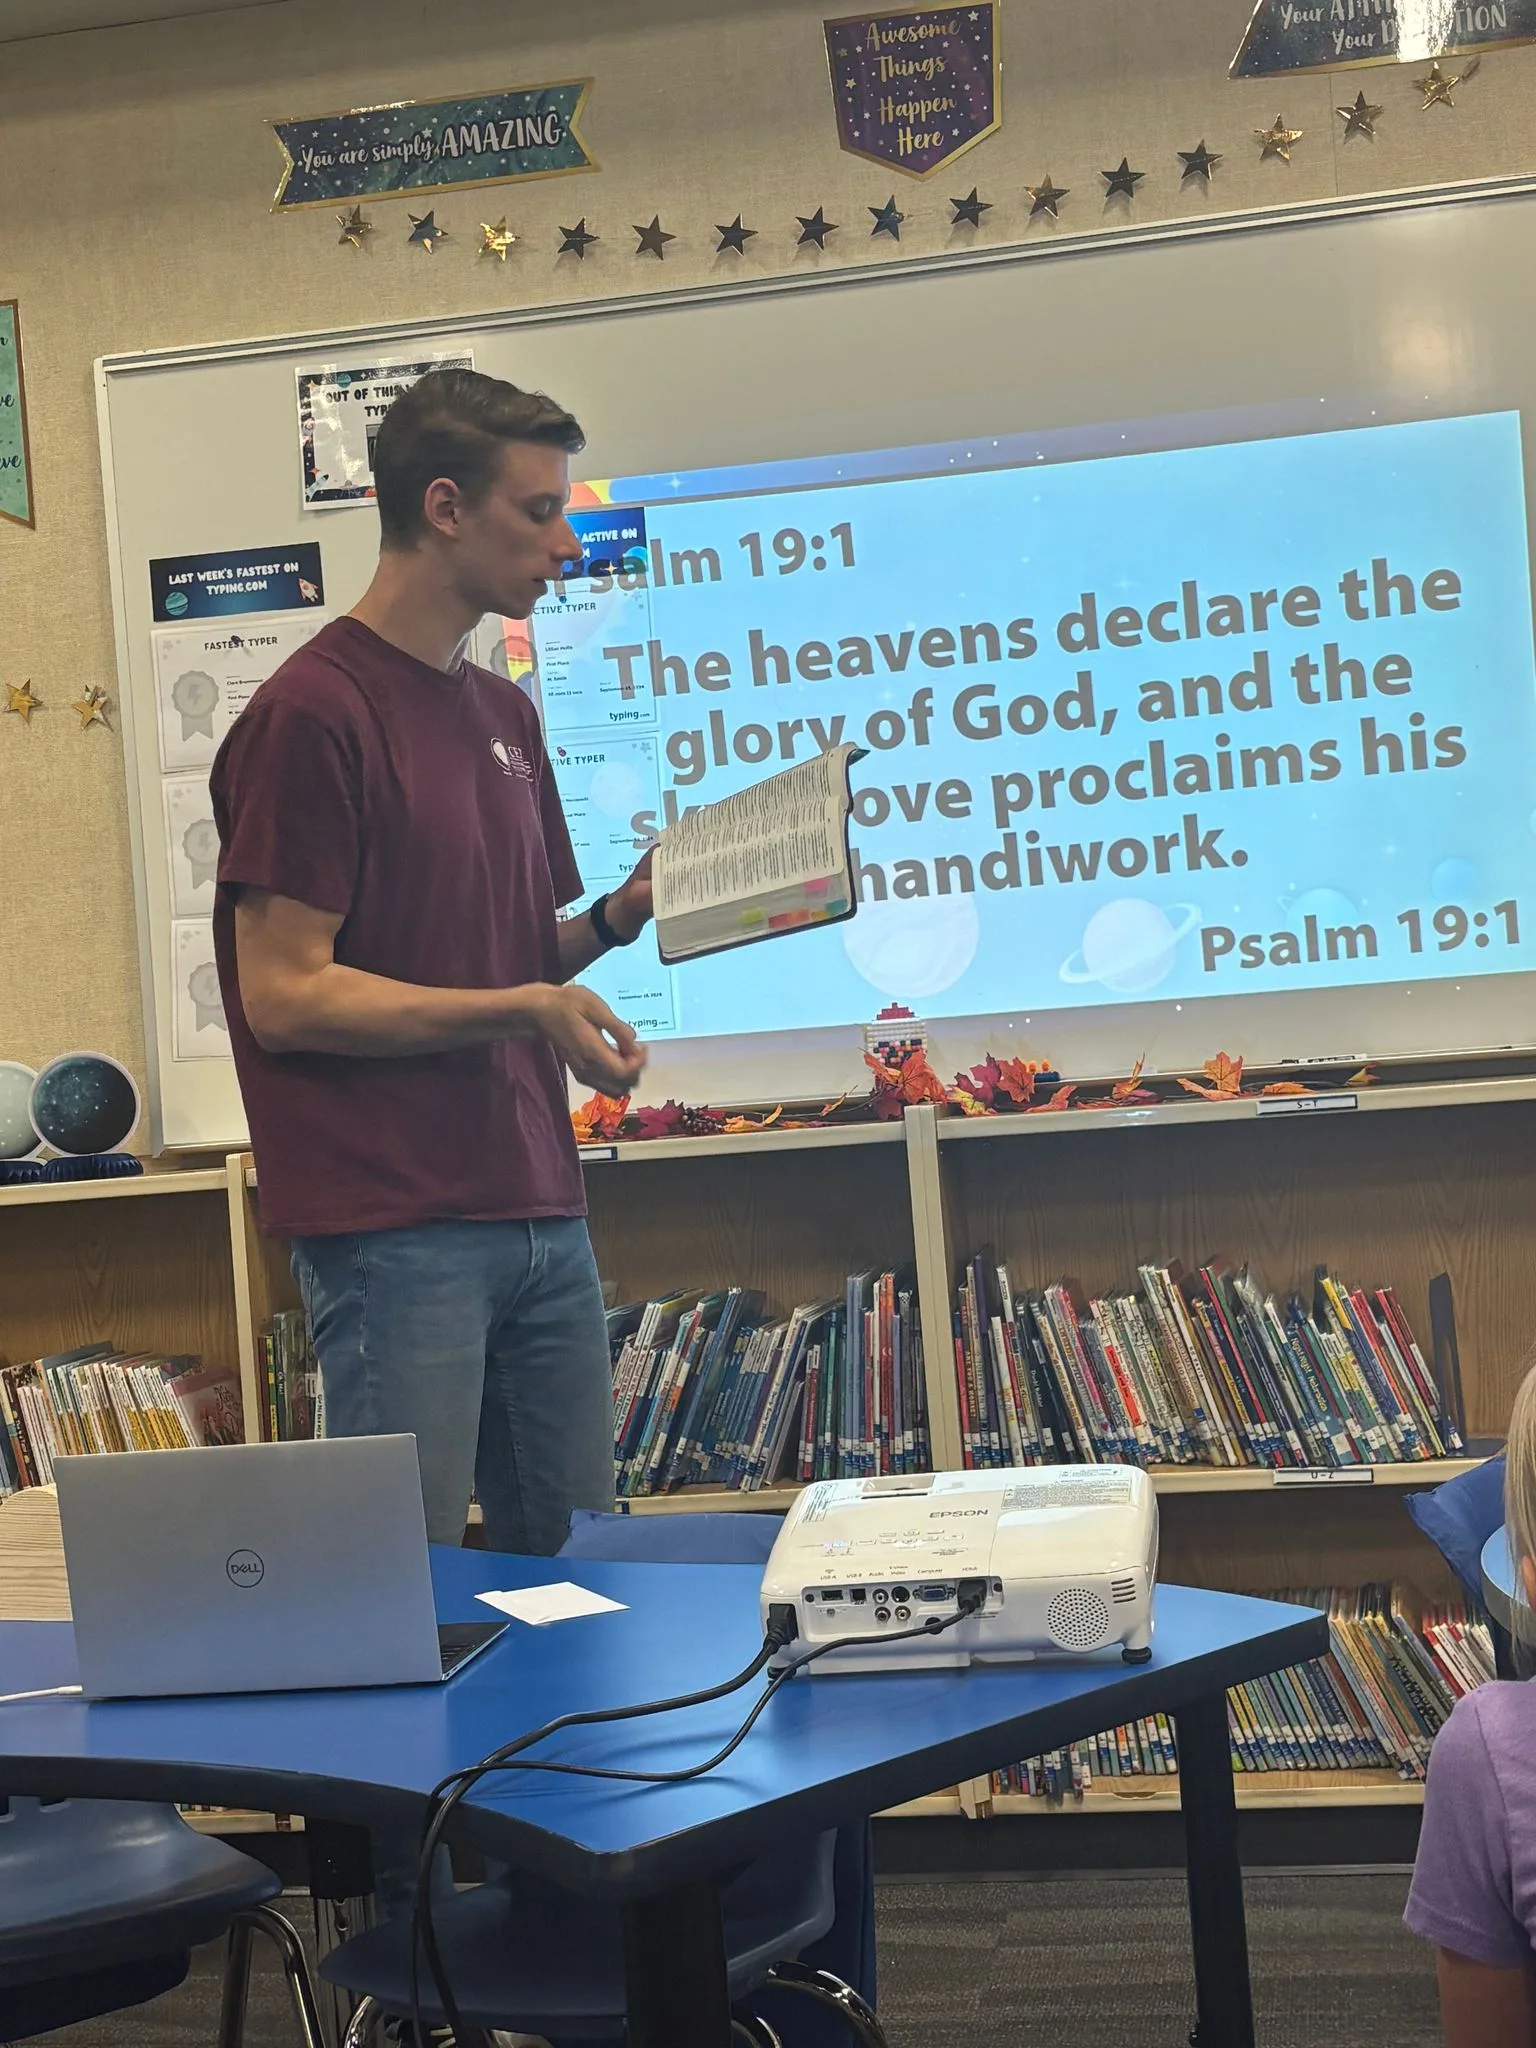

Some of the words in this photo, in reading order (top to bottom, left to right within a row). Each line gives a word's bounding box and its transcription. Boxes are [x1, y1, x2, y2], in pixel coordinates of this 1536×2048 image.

[1280, 3, 1325, 30] Your
[864, 20, 961, 51] Awesome
[1331, 28, 1377, 55] Your
[873, 55, 947, 83] Things
[877, 96, 957, 126] Happen
[301, 147, 335, 174] You
[339, 147, 369, 165] are
[372, 134, 434, 163] simply
[442, 113, 563, 158] AMAZING
[897, 126, 945, 156] Here
[325, 390, 350, 403] OUT
[354, 388, 369, 400] OF
[581, 529, 618, 543] ACTIVE
[621, 528, 638, 539] ON
[738, 522, 856, 577] 19:1
[168, 573, 194, 585] LAST
[197, 567, 233, 583] WEEK'S
[236, 564, 280, 579] FASTEST
[284, 562, 299, 573] ON
[206, 580, 268, 595] TYPING.COM
[532, 604, 562, 614] CTIVE
[566, 602, 597, 612] TYPER
[603, 639, 731, 700] The
[748, 616, 1038, 687] heavens
[1056, 580, 1321, 653] declare
[1338, 557, 1462, 622] the
[204, 639, 246, 651] FASTEST
[248, 636, 278, 647] TYPER
[665, 709, 846, 786] glory
[864, 688, 934, 751] of
[952, 670, 1118, 741] God,
[1137, 650, 1273, 723] and
[1290, 642, 1413, 706] the
[574, 754, 606, 765] TYPER
[851, 780, 973, 828] ove
[991, 732, 1342, 828] proclaims
[1360, 711, 1467, 776] his
[851, 813, 1249, 903] handiwork.
[1200, 913, 1379, 972] Psalm
[1397, 899, 1520, 954] 19:1
[929, 1509, 989, 1519] EPSON
[230, 1563, 261, 1575] DELL
